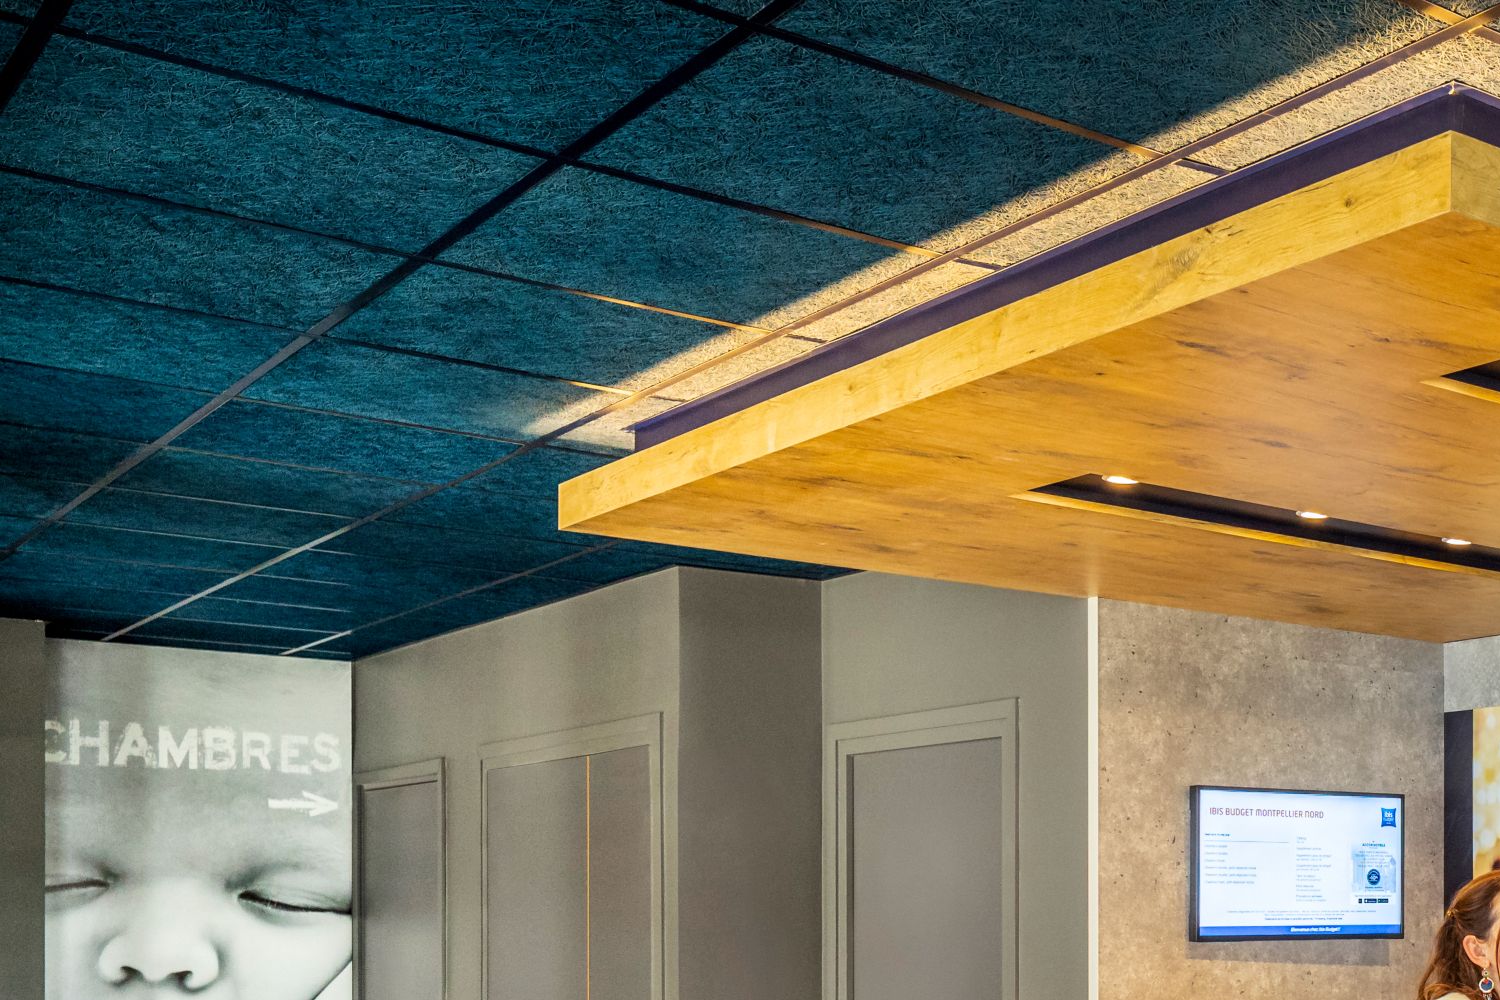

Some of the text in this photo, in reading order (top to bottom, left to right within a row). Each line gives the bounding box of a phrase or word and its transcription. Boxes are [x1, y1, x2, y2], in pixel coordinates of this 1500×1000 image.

[1209, 807, 1324, 819] IBIS BUDGET MONTPELLIER NORD
